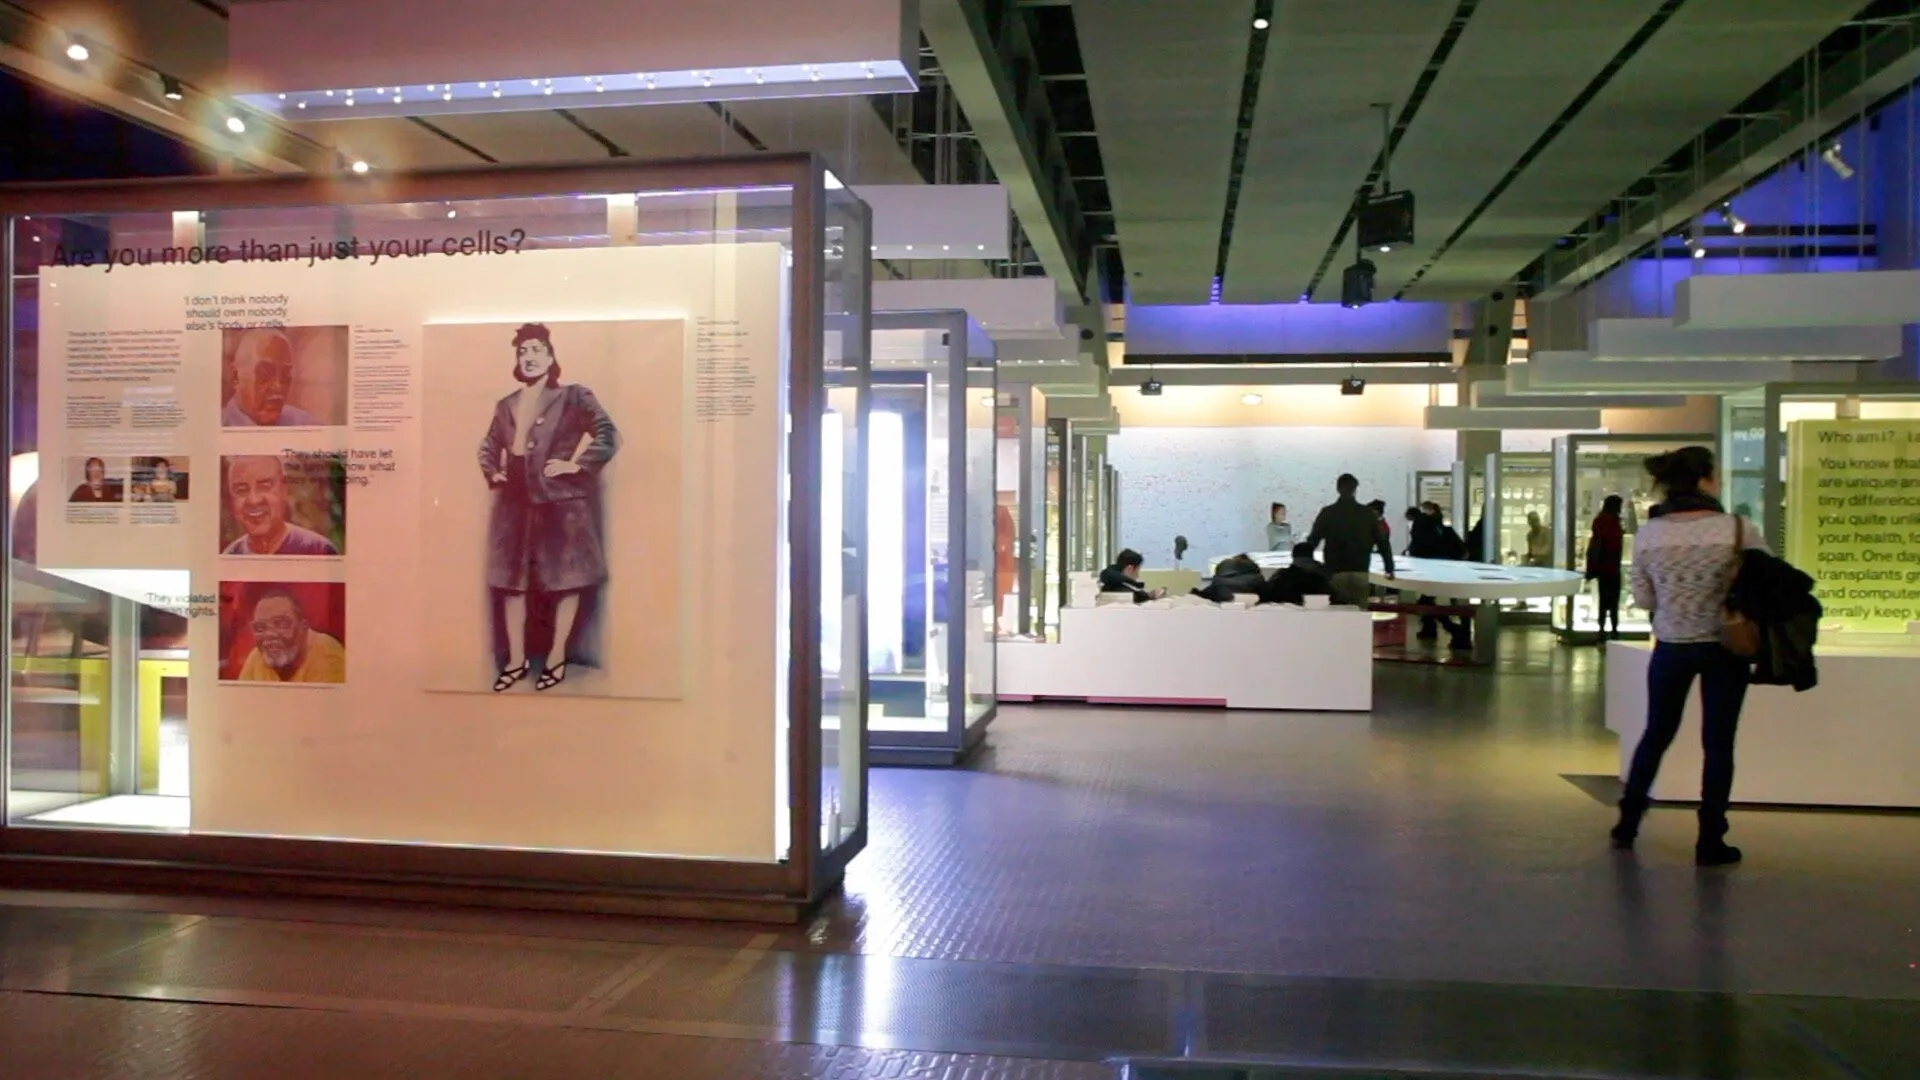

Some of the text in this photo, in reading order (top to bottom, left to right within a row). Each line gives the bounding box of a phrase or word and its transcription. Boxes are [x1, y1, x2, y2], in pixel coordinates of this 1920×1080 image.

[51, 228, 526, 273] Are you more than just your cells?
[221, 295, 246, 304] think
[248, 294, 289, 305] nobody
[186, 307, 287, 318] should own nobody
[1818, 431, 1853, 443] Who
[1856, 433, 1879, 443] am
[351, 448, 377, 458] have
[379, 448, 393, 458] let
[368, 462, 396, 471] what
[1819, 457, 1920, 469] You know tha
[1818, 478, 1843, 488] are
[1846, 477, 1897, 491] unique
[1818, 495, 1844, 509] tiny
[1818, 515, 1845, 528] you
[1849, 514, 1887, 527] quite
[1818, 534, 1850, 546] your
[1854, 532, 1906, 545] health,
[1818, 552, 1858, 564] span.
[1862, 549, 1893, 562] One
[1818, 568, 1902, 583] transplants
[1818, 587, 1846, 598] and
[1874, 606, 1911, 620] keep
